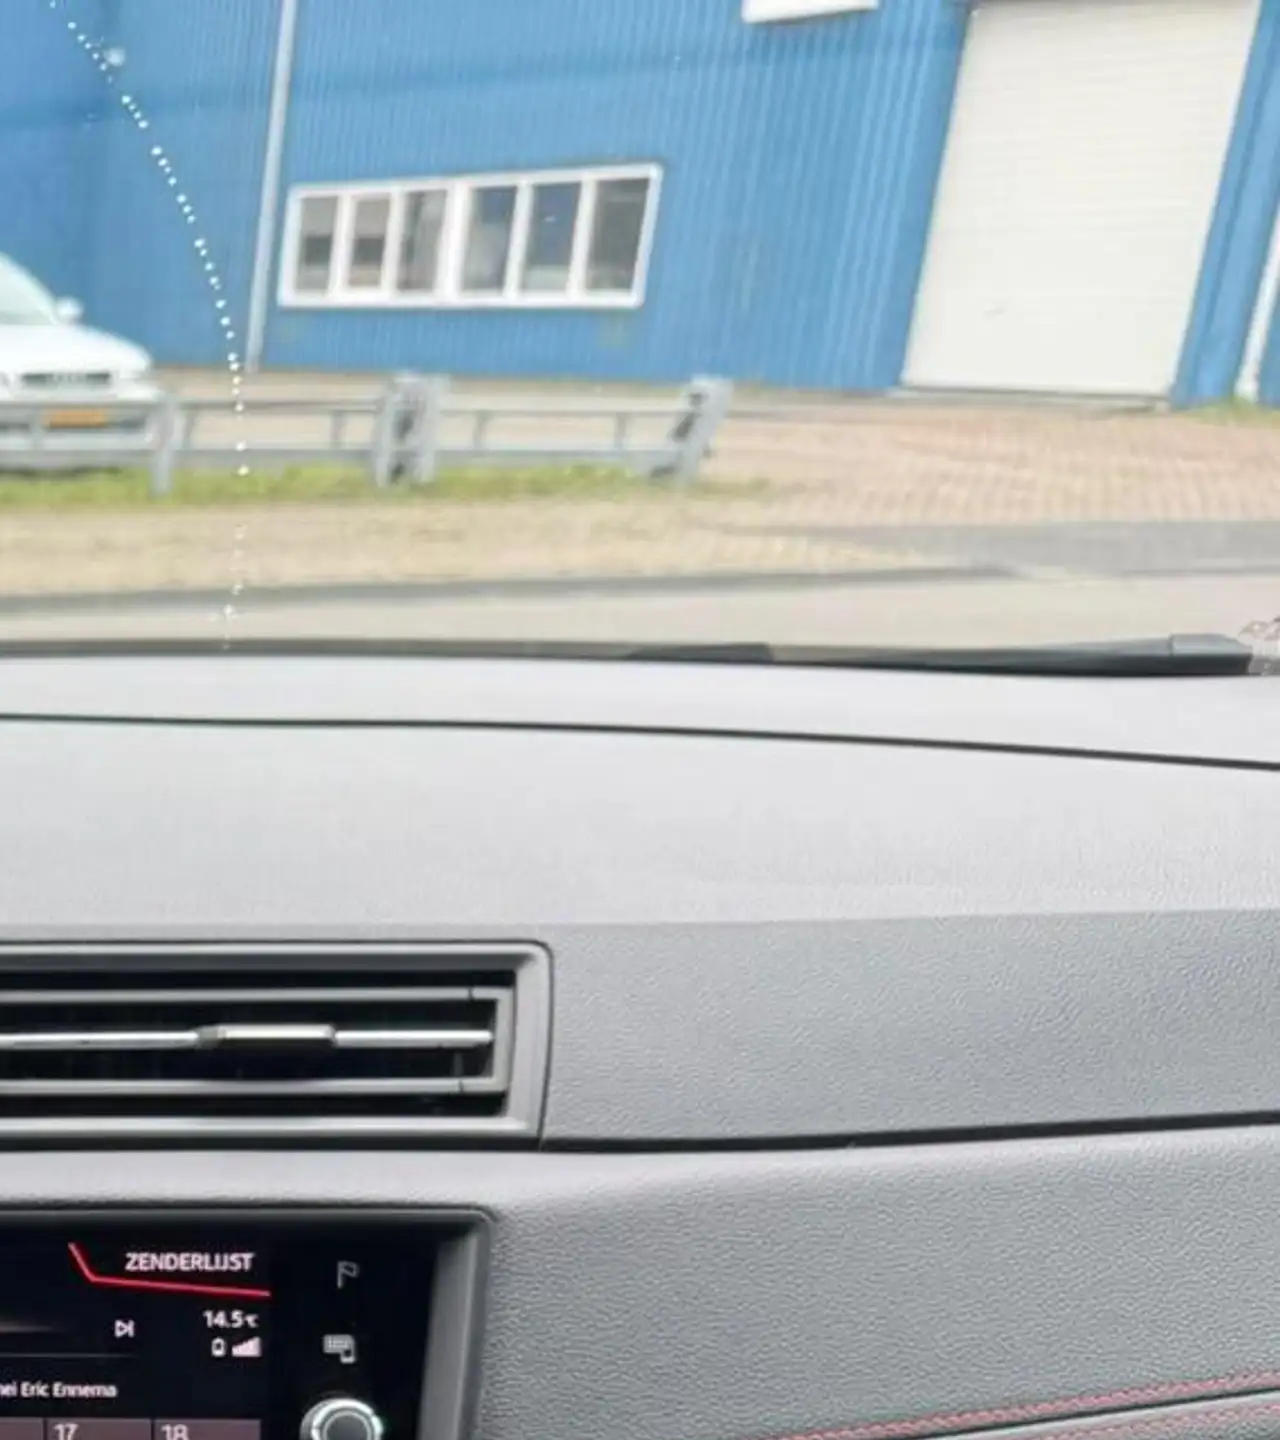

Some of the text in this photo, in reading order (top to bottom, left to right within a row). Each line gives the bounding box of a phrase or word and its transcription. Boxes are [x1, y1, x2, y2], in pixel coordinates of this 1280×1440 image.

[125, 1253, 253, 1271] ZENDERLIJST
[21, 1382, 48, 1397] Eric
[53, 1382, 117, 1397] Ennema
